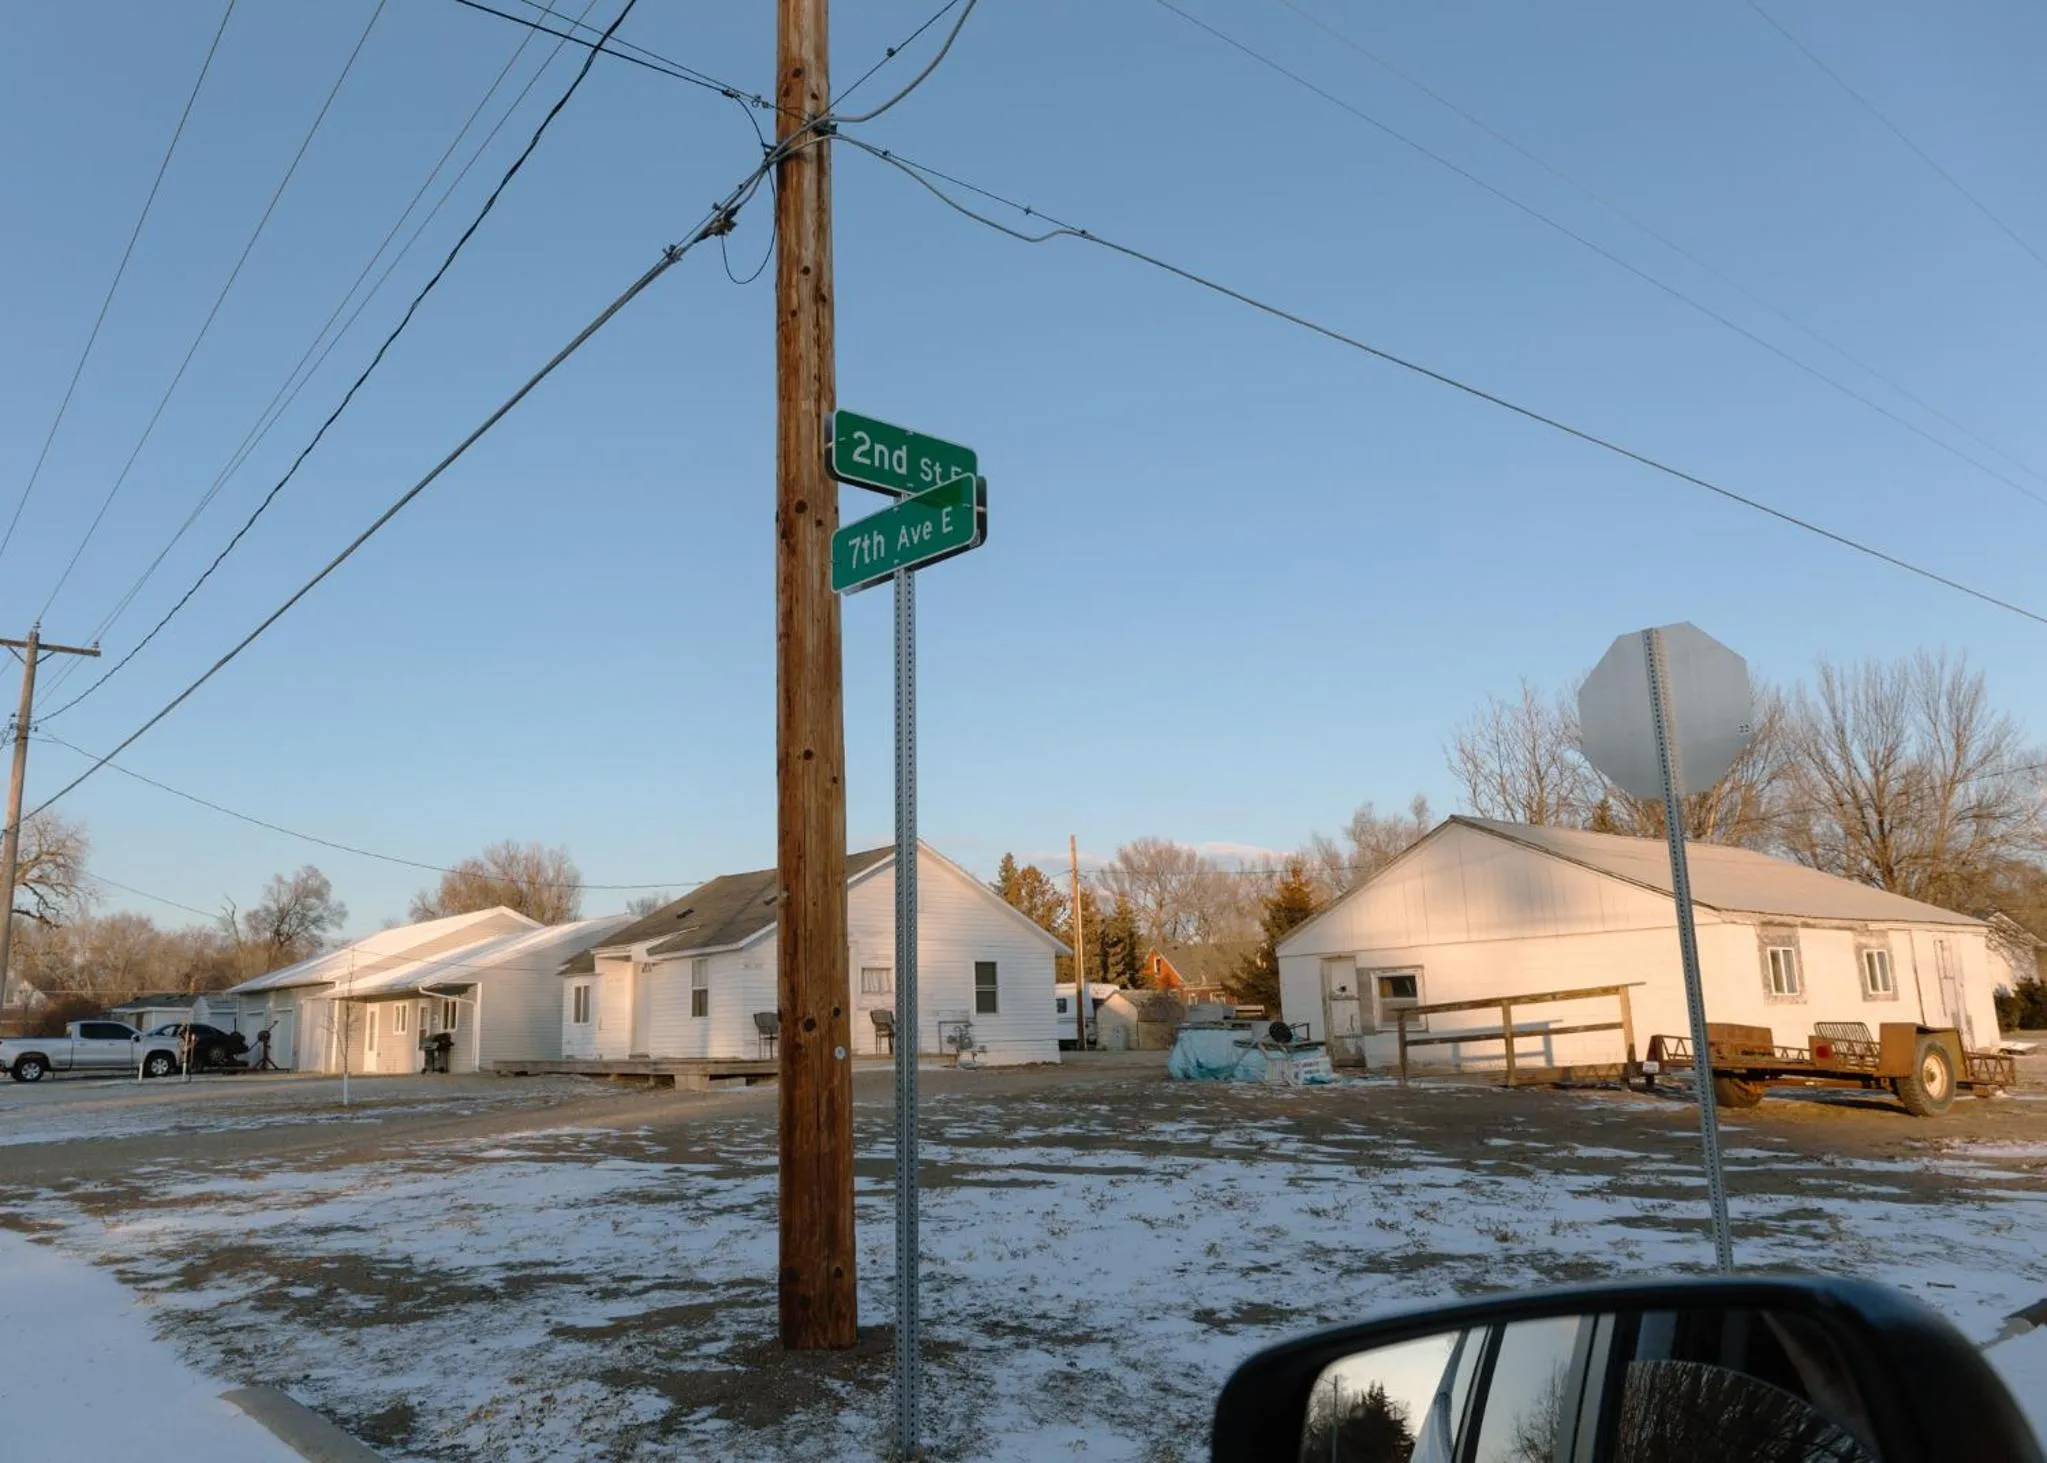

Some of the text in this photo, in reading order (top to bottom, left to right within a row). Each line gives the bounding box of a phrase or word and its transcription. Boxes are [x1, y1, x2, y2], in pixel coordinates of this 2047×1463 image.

[852, 430, 907, 475] 2nd
[920, 457, 942, 485] St
[848, 507, 953, 569] 7th Ave E
